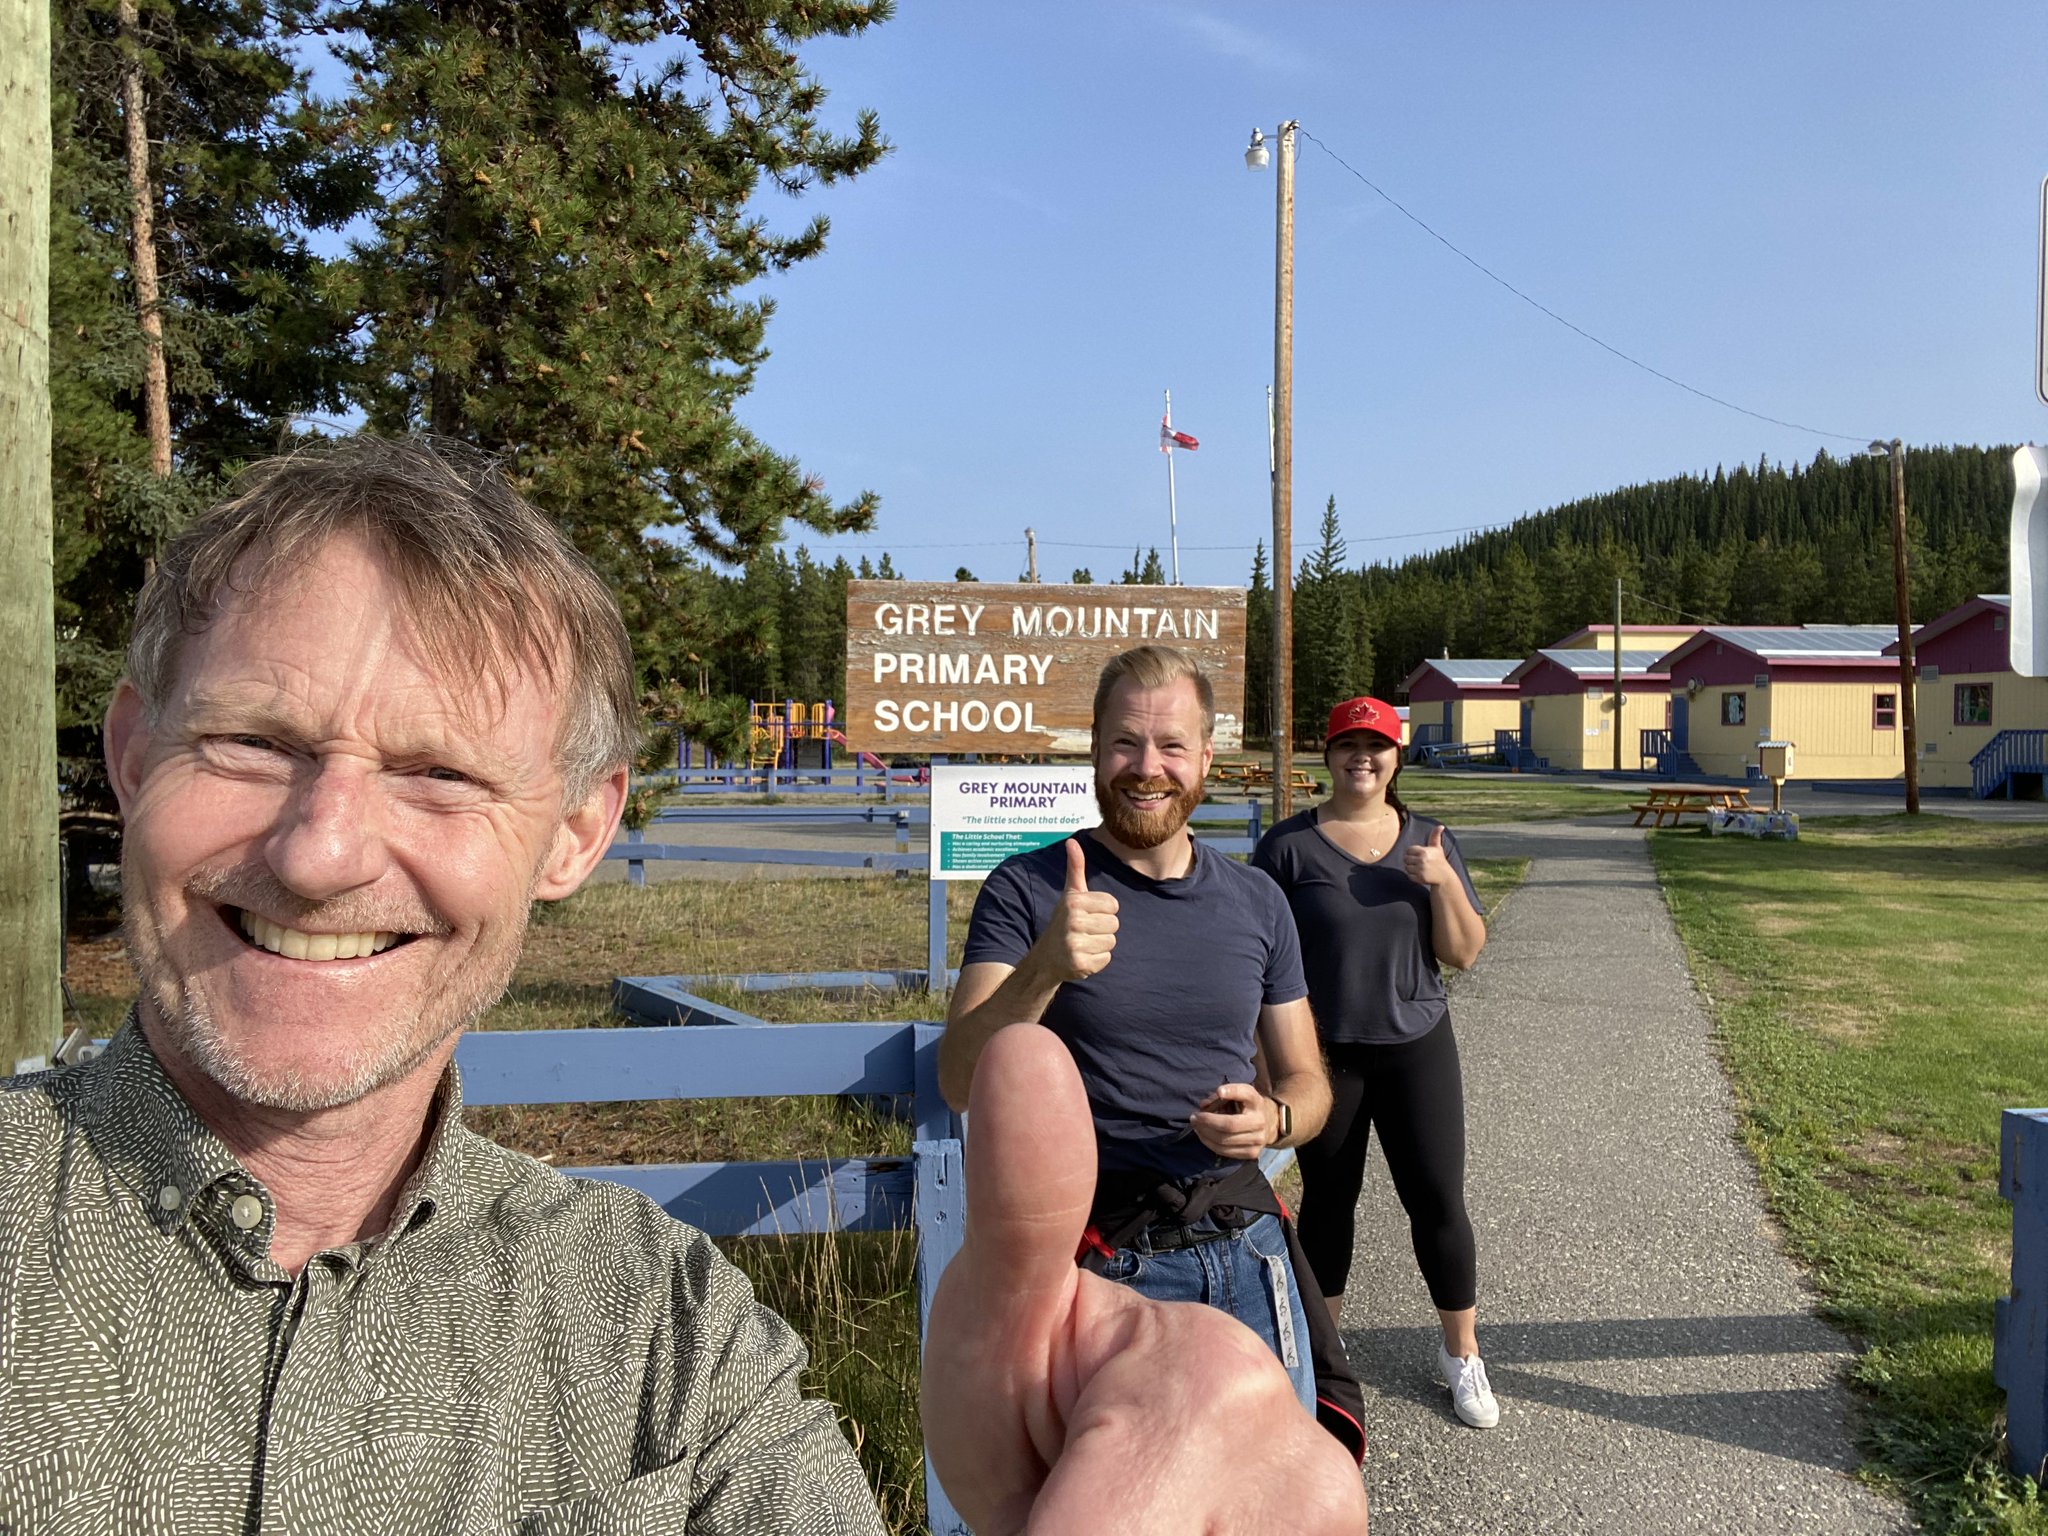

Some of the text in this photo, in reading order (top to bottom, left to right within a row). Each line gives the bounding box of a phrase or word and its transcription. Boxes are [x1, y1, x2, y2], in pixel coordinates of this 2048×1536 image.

[875, 603, 1218, 639] GREY MOUNTAIN
[874, 653, 1054, 685] PRIMARY
[873, 700, 1047, 733] SCHOOL
[959, 782, 1087, 795] GREY MOUNTAIN
[990, 796, 1057, 808] PRIMARY
[983, 815, 1006, 825] little
[1007, 816, 1037, 825] school
[1039, 816, 1057, 825] that
